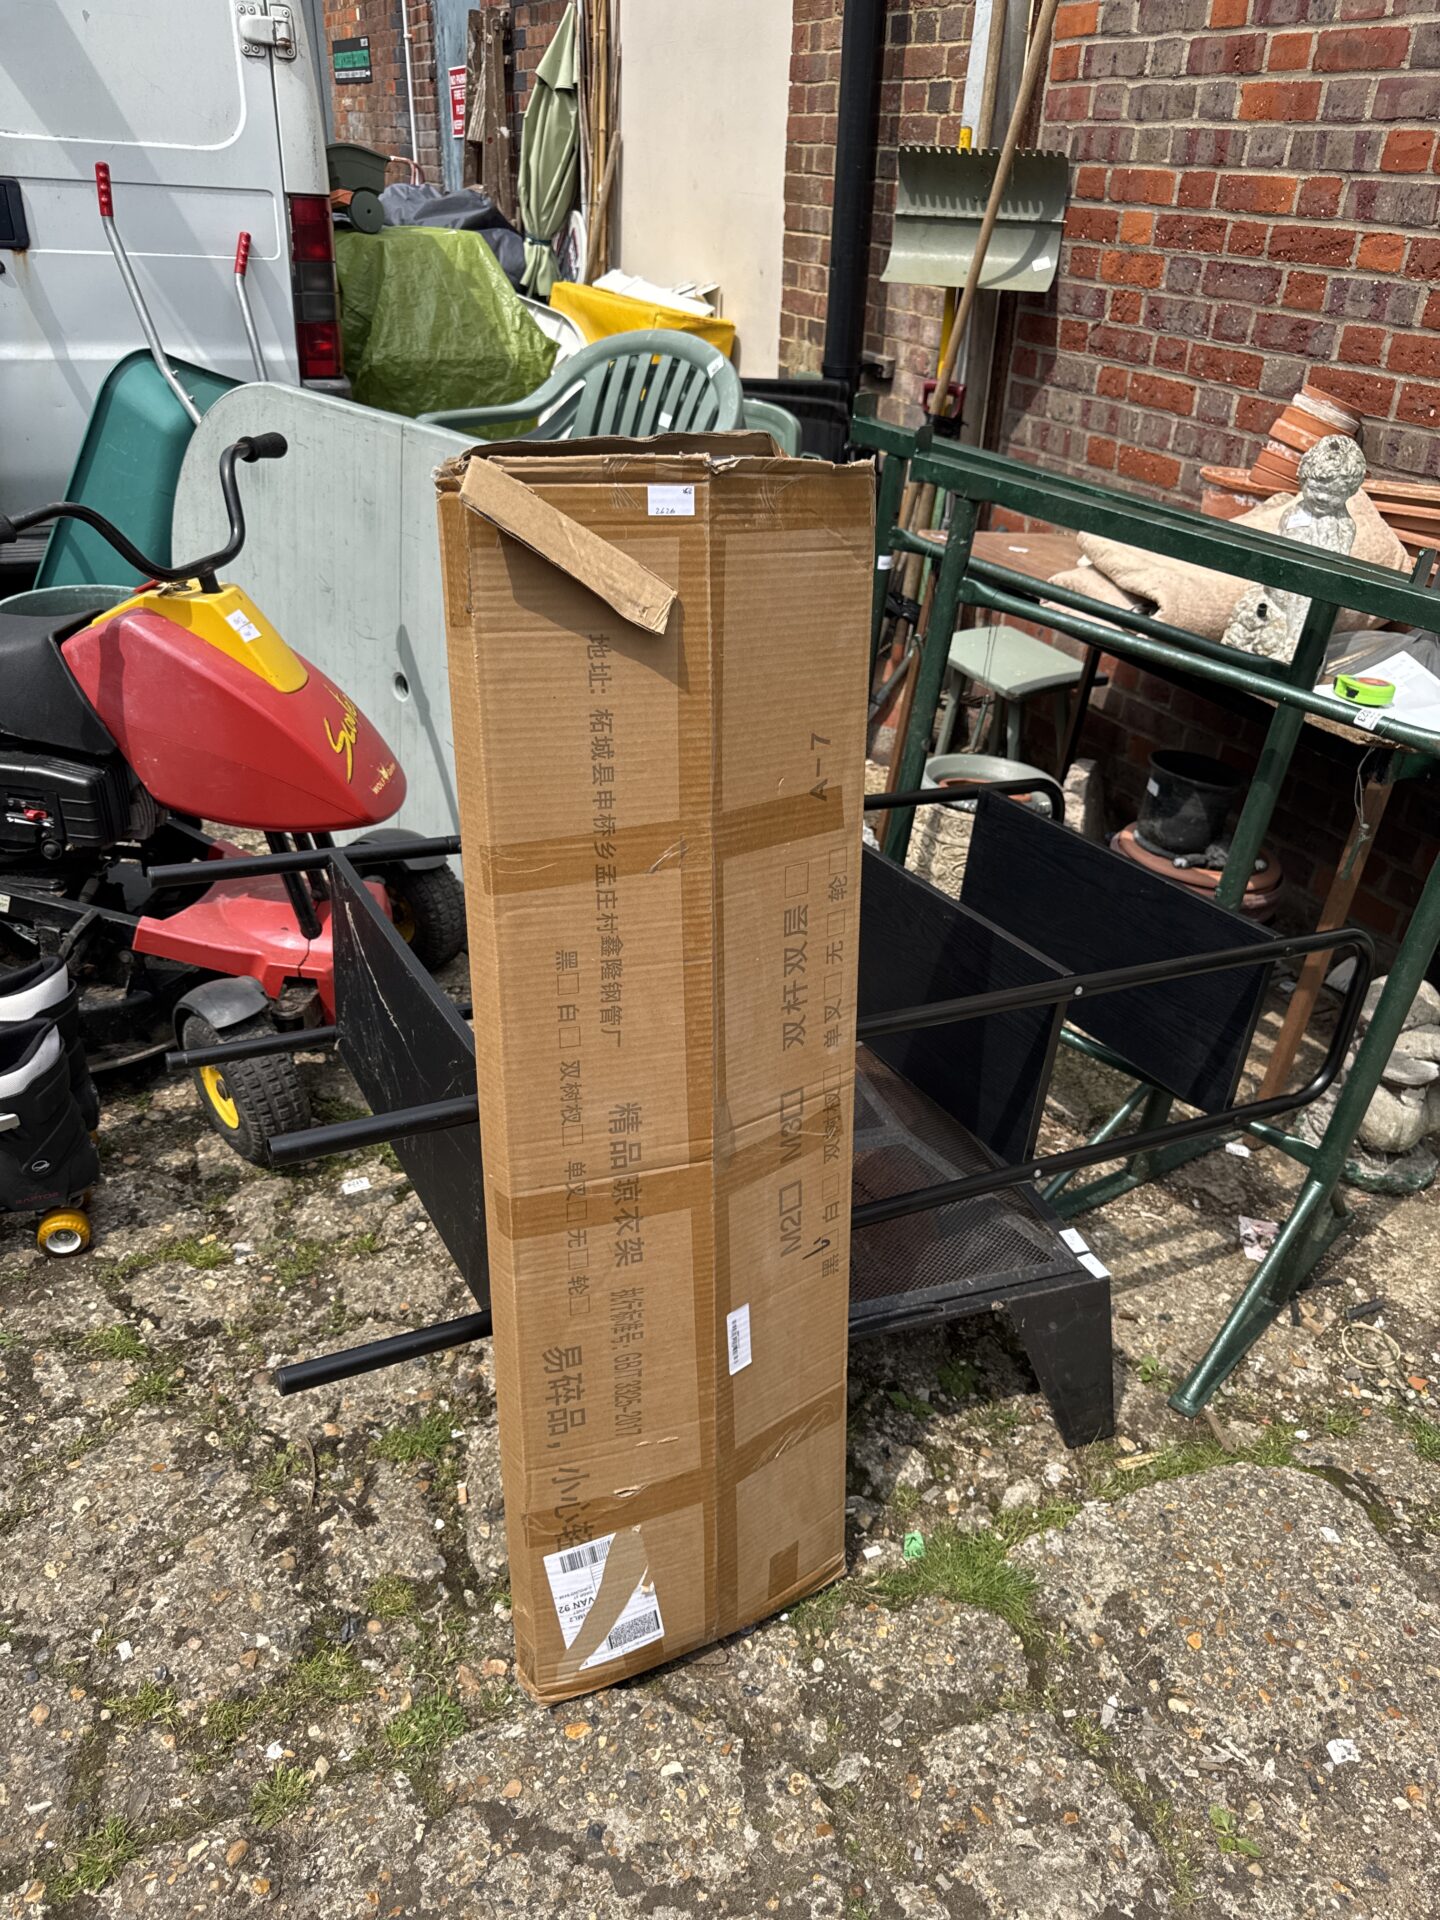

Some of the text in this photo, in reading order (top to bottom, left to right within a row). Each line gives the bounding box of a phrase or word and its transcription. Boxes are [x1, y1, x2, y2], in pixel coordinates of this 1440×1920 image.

[781, 904, 809, 1051] 双杆双层
[608, 1103, 645, 1268] 精品晾衣架
